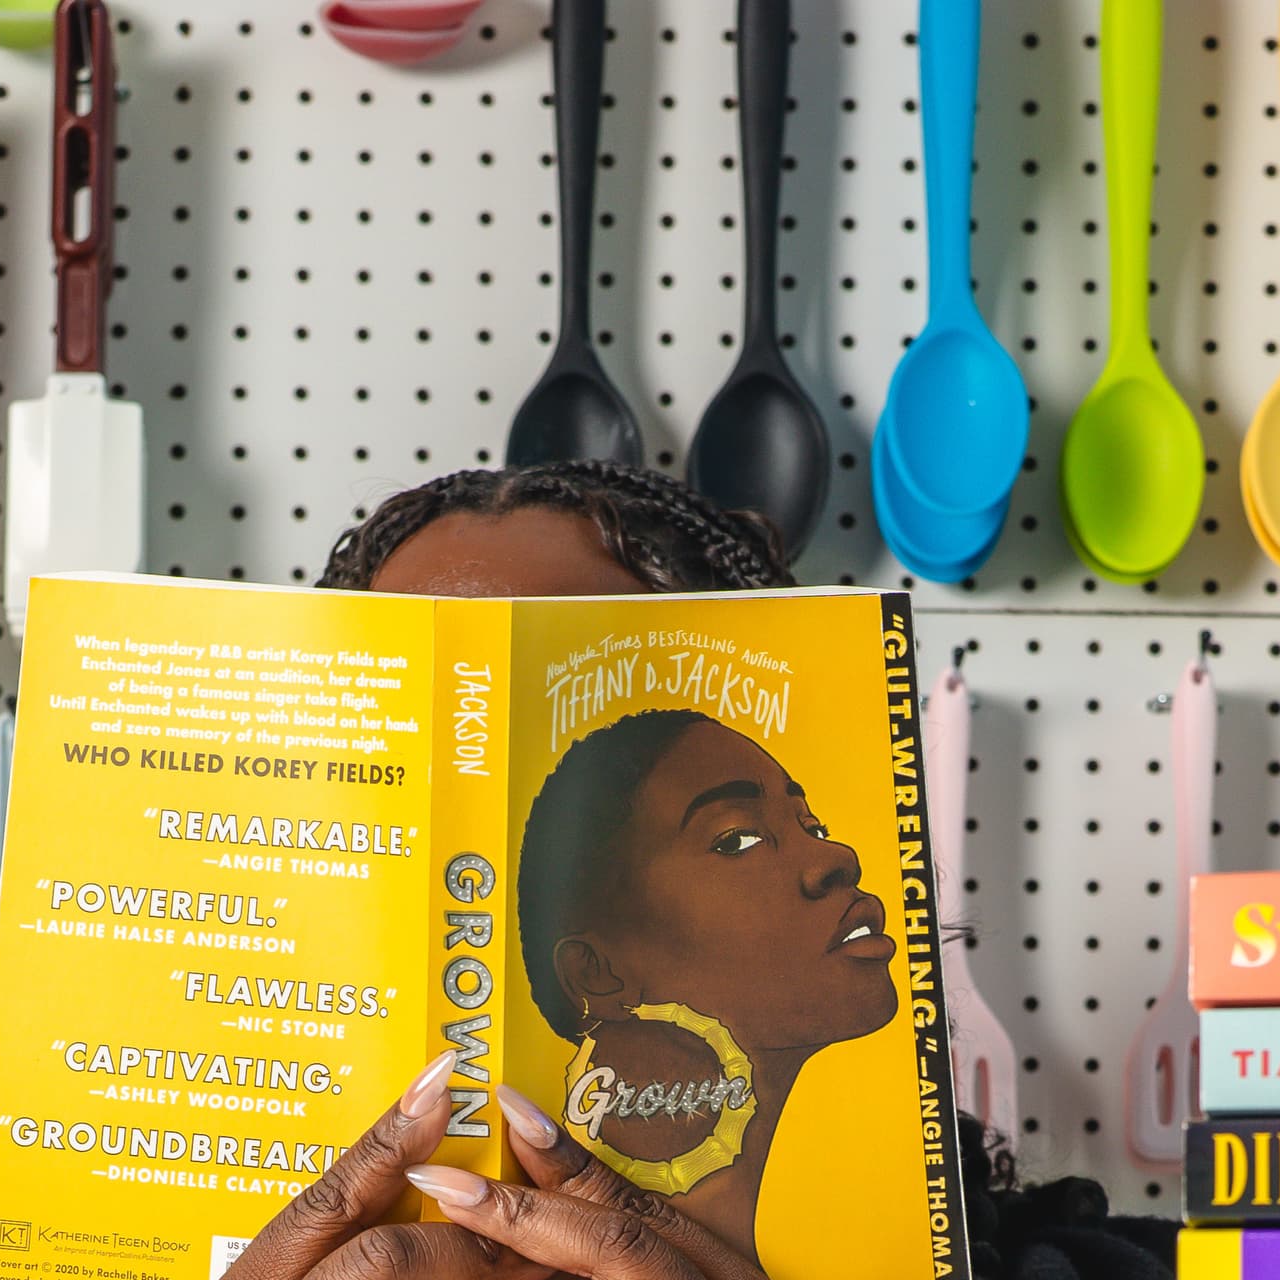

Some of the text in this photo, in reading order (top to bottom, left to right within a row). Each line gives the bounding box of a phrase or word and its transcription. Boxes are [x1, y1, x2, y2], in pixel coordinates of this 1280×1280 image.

[74, 634, 408, 671] When legendary R&B artist Korey Fields spots
[546, 661, 568, 687] New
[600, 633, 643, 658] Times
[647, 630, 737, 655] BESTSELLING
[742, 649, 794, 675] AUTHOR
[81, 656, 401, 689] Enchanted Jones at an audition, her dreams
[49, 694, 419, 733] Until Enchanted wakes up with blood on her hands
[108, 678, 379, 712] of being a famous singer take flight.
[545, 651, 790, 753] TIFFANY D. JACKSON
[91, 719, 388, 754] and zero memory of the previous night.
[453, 661, 492, 776] JACKSON
[63, 743, 406, 787] WHO KILLED KOREY FIELDS?
[143, 807, 418, 859] “REMARKABLE.”
[289, 858, 370, 879] THOMAS
[36, 879, 287, 929] “POWERFUL.”
[113, 924, 176, 945] HALSE
[183, 931, 296, 955] ANDERSON
[170, 970, 397, 1019] “FLAWLESS.”
[444, 852, 496, 1139] GROWN
[280, 1020, 346, 1040] STONE
[50, 1039, 352, 1095] “CAPTIVATING.”
[188, 1094, 307, 1118] WOODFOLK
[567, 1066, 749, 1141] Grown
[226, 1176, 312, 1198] CLAYTO
[24, 1262, 39, 1271] art
[55, 1263, 80, 1275] 2020
[82, 1265, 95, 1278] by
[97, 1268, 138, 1280] Rachelle
